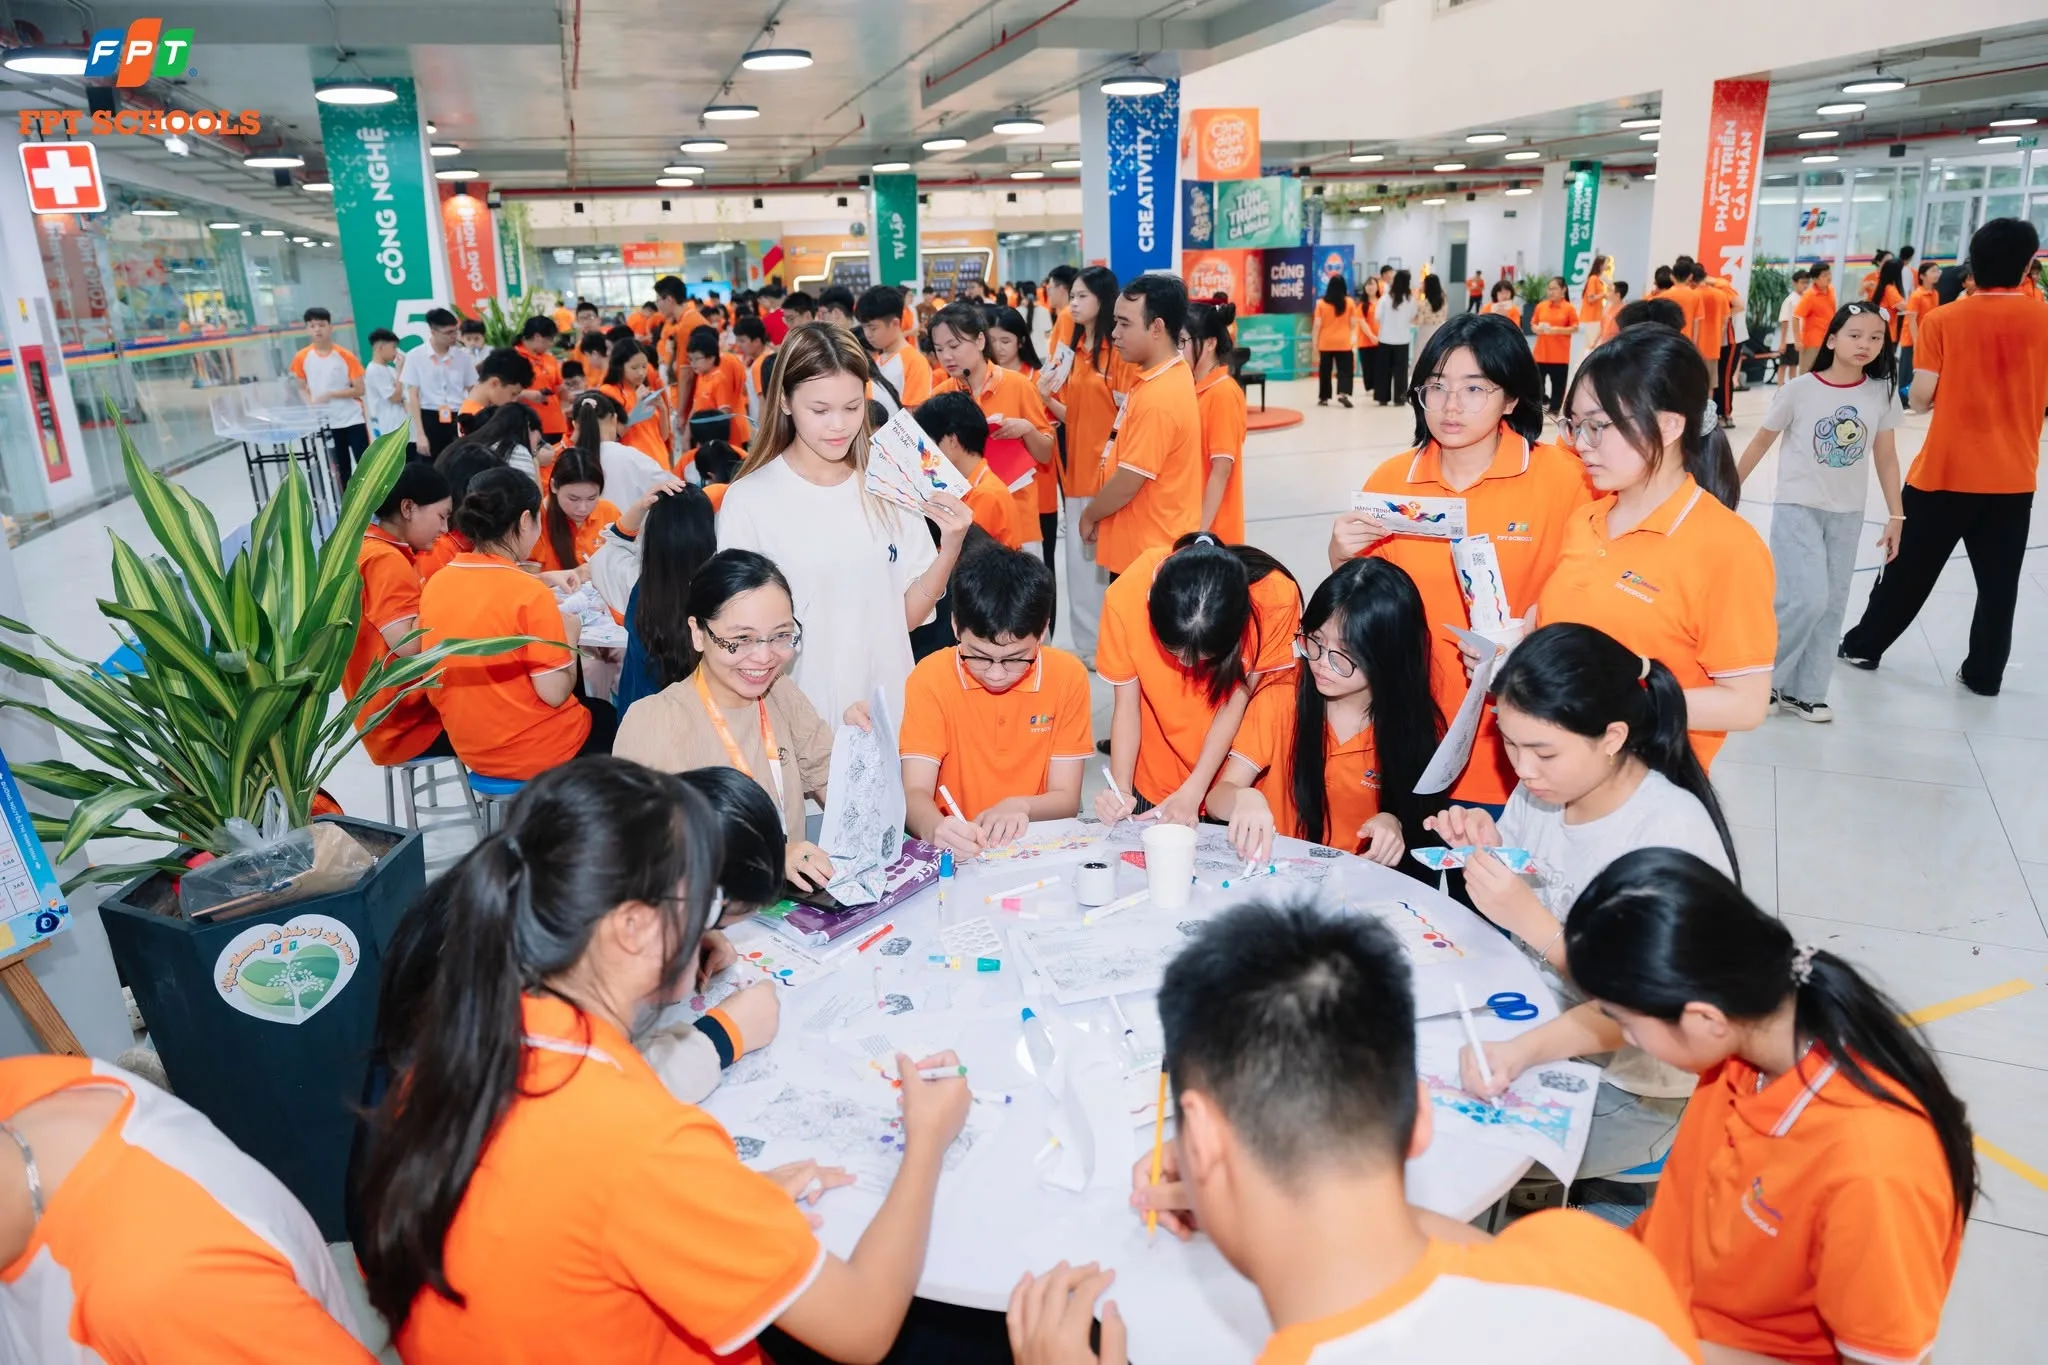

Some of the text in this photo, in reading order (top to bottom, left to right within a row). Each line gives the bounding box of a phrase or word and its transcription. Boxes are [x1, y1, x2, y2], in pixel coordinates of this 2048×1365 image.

[1716, 119, 1736, 176] TRIỂN
[1137, 125, 1155, 252] CREATIVITY
[1731, 131, 1753, 221] CÁ NHÂN
[356, 127, 407, 285] CÔNG NGHỆ
[1714, 181, 1731, 232] PHÁT
[466, 249, 484, 292] CÔNG
[1271, 262, 1304, 279] CÔNG
[1271, 280, 1304, 299] NGHỆ
[1571, 251, 1591, 284] 5
